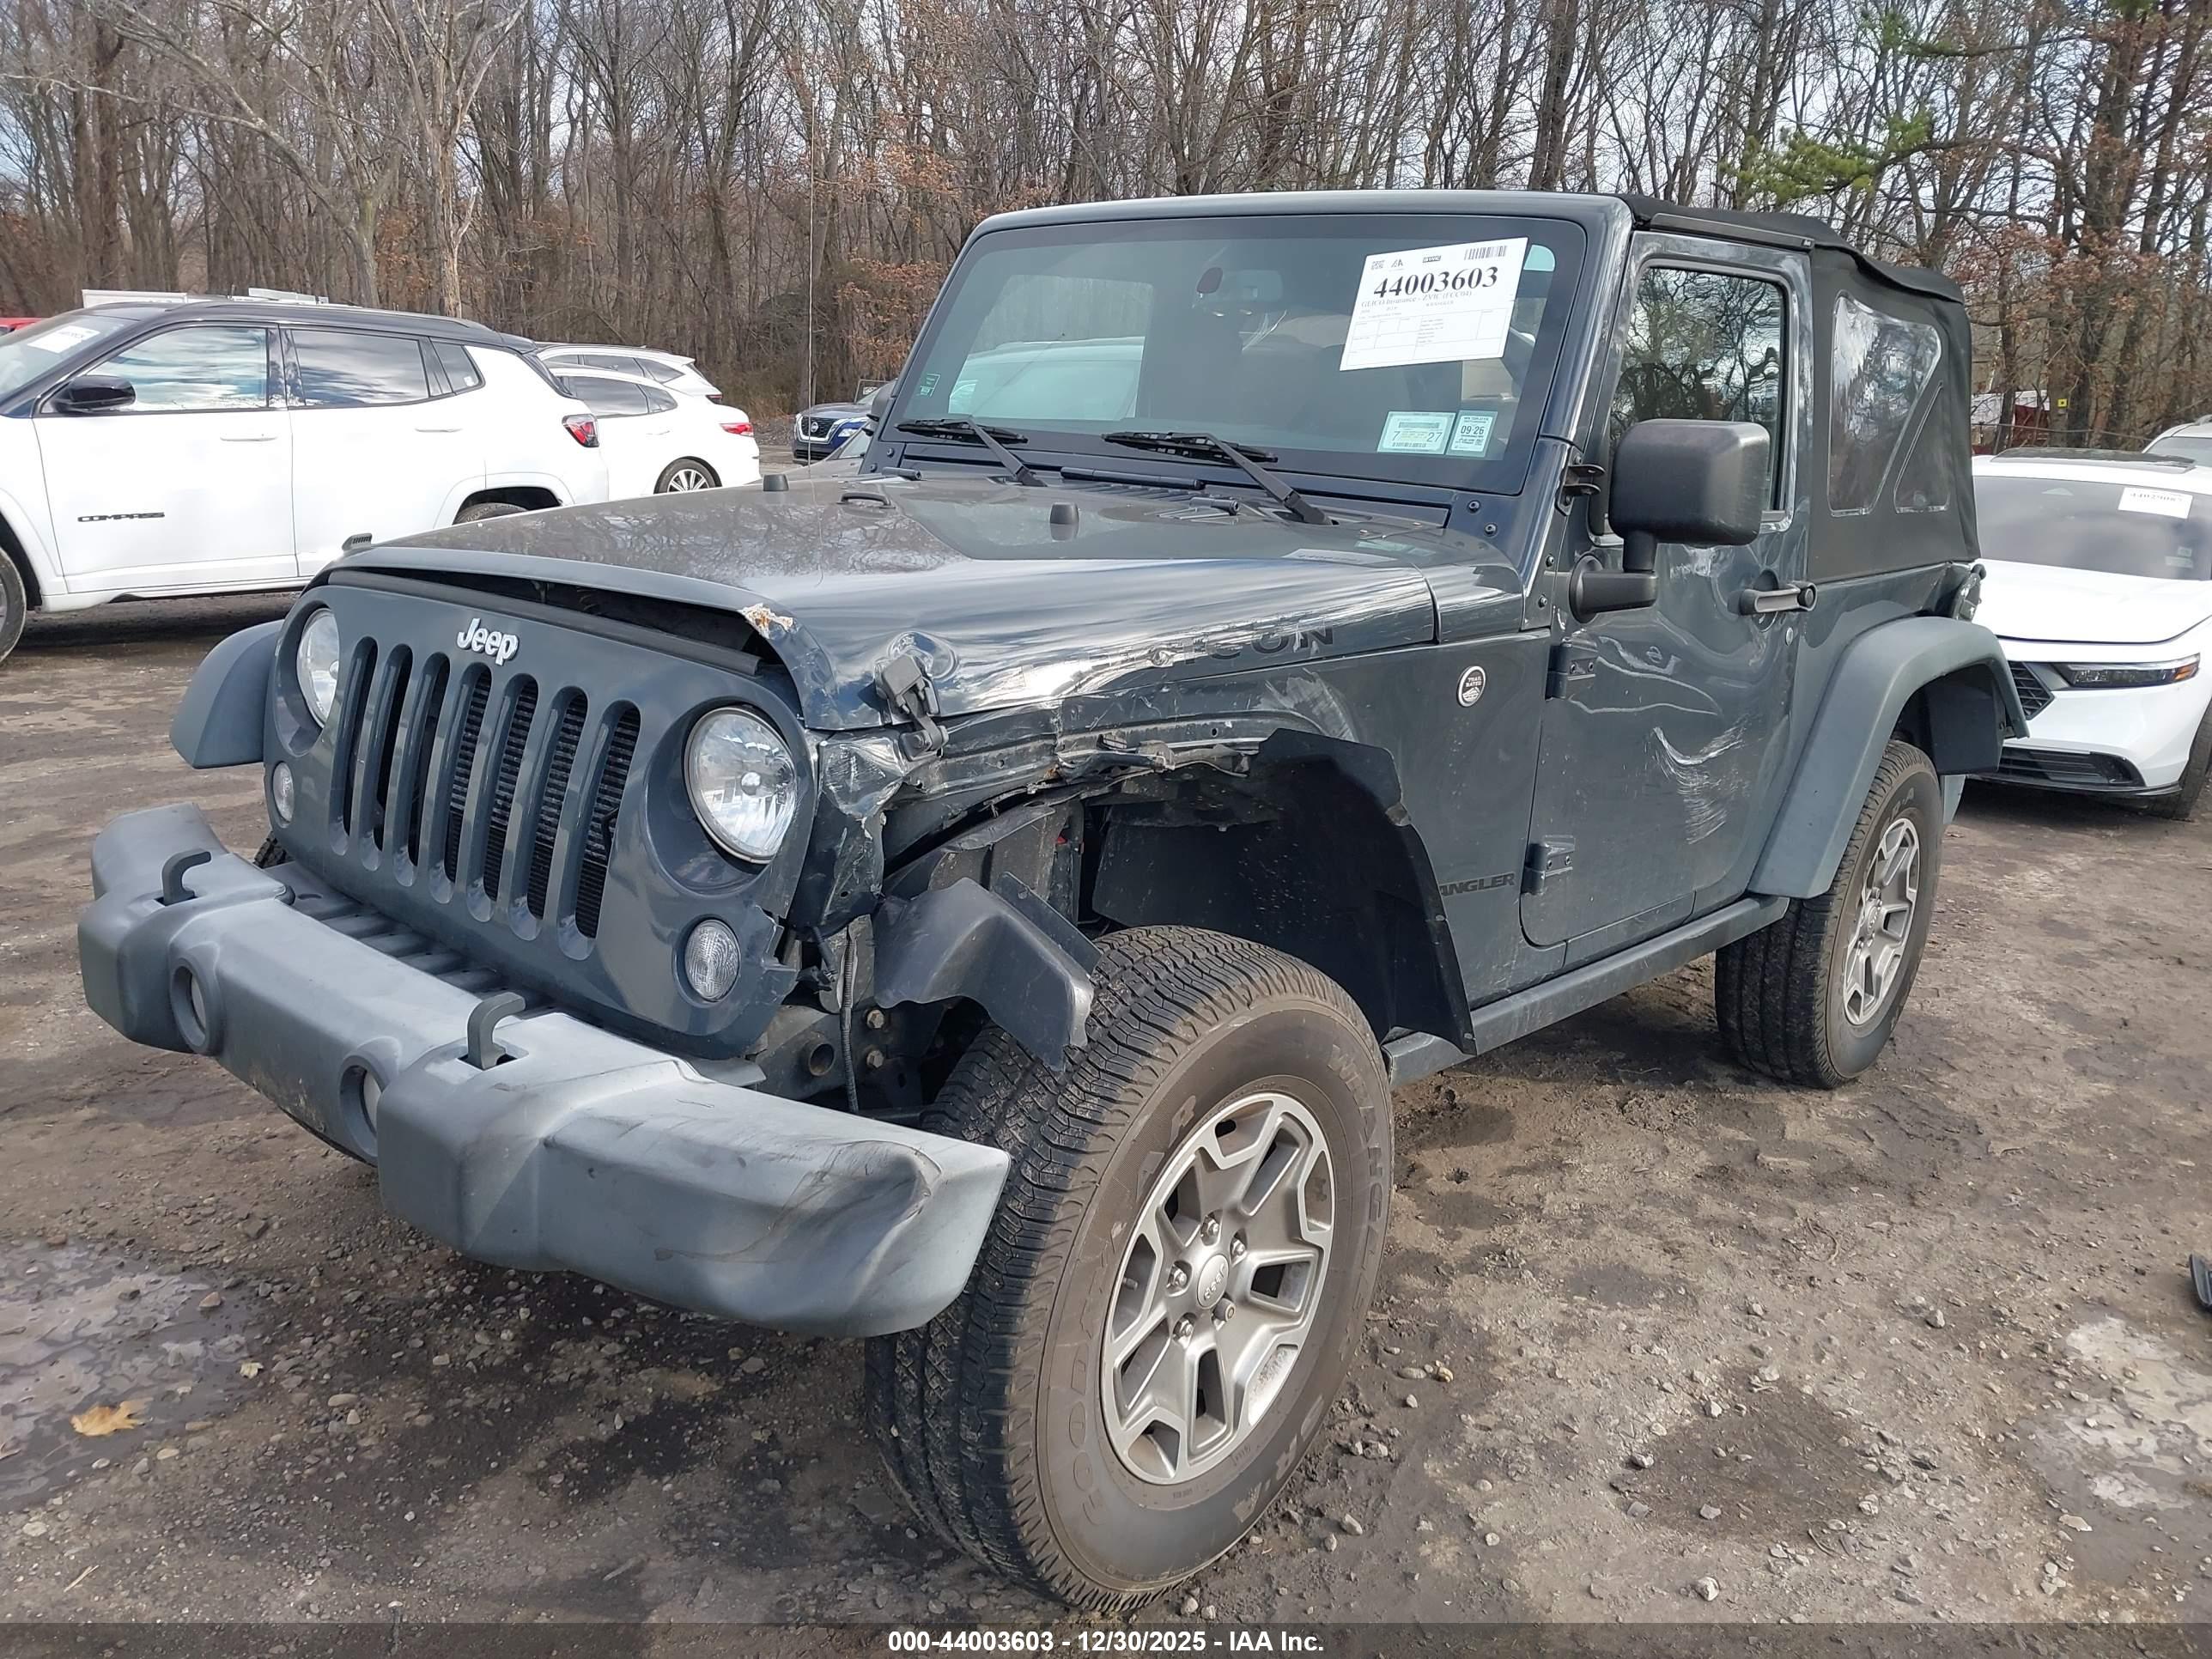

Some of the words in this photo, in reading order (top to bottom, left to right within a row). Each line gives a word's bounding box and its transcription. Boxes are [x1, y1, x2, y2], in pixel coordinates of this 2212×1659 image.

[1374, 266, 1498, 298] 44003603
[1392, 430, 1401, 441] 7
[1426, 431, 1443, 443] 27
[76, 512, 165, 522] COMPASS
[457, 618, 519, 666] Jeep
[1204, 1262, 1225, 1301] Jeep
